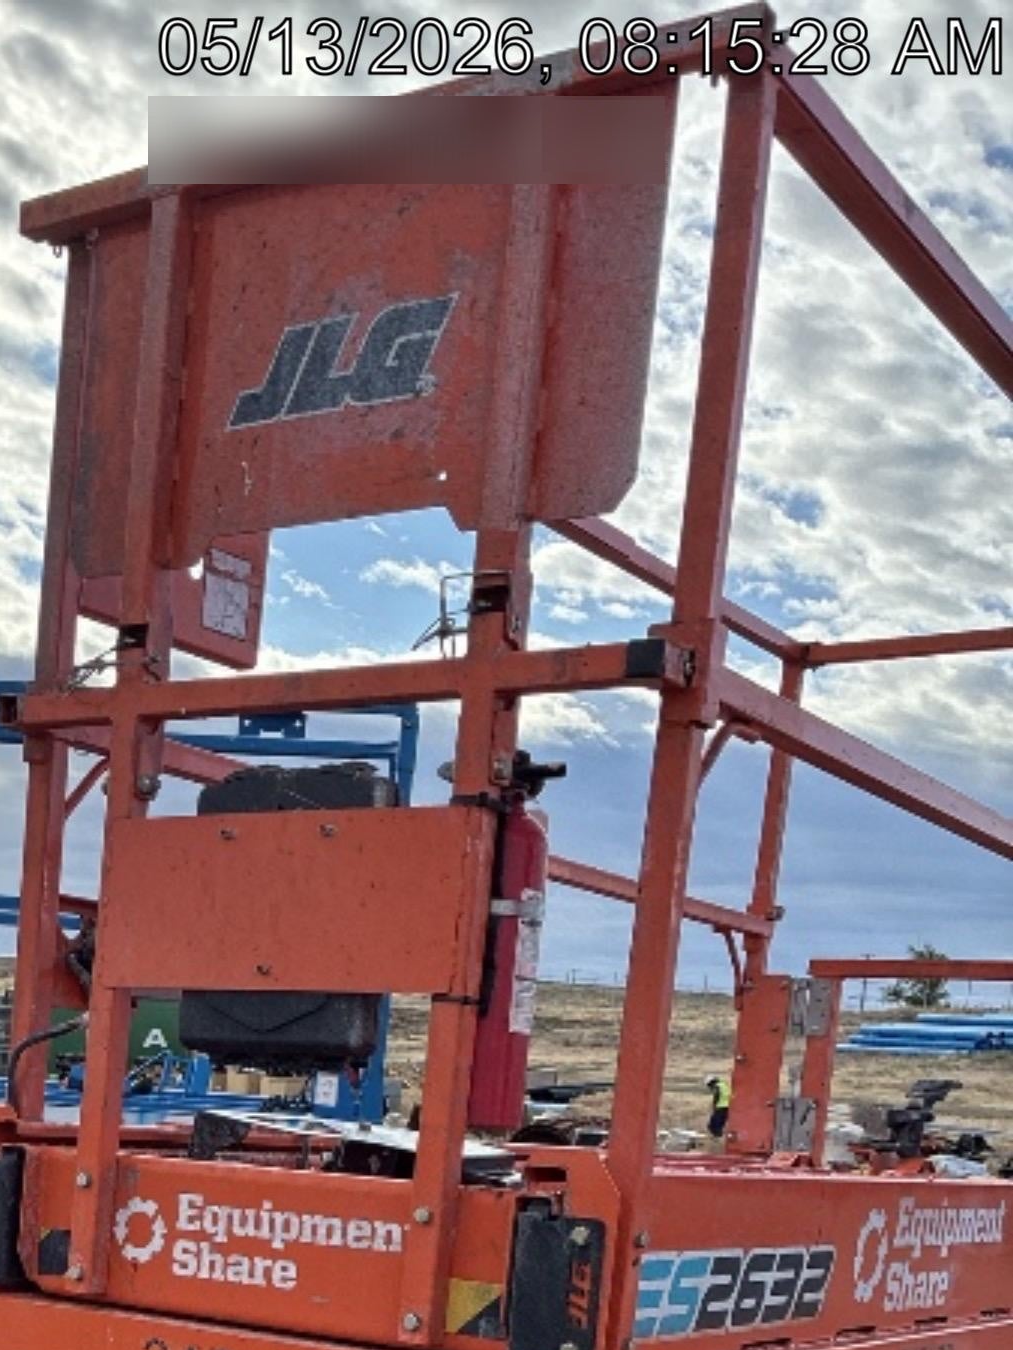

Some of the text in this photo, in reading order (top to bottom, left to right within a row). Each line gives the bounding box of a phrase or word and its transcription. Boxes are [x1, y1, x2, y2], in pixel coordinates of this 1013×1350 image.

[226, 291, 461, 432] JLG
[175, 1192, 410, 1252] Equipmen
[892, 1196, 1006, 1258] Equipment
[171, 1238, 298, 1290] Share
[632, 1244, 837, 1345] ES2632
[884, 1261, 950, 1312] Share
